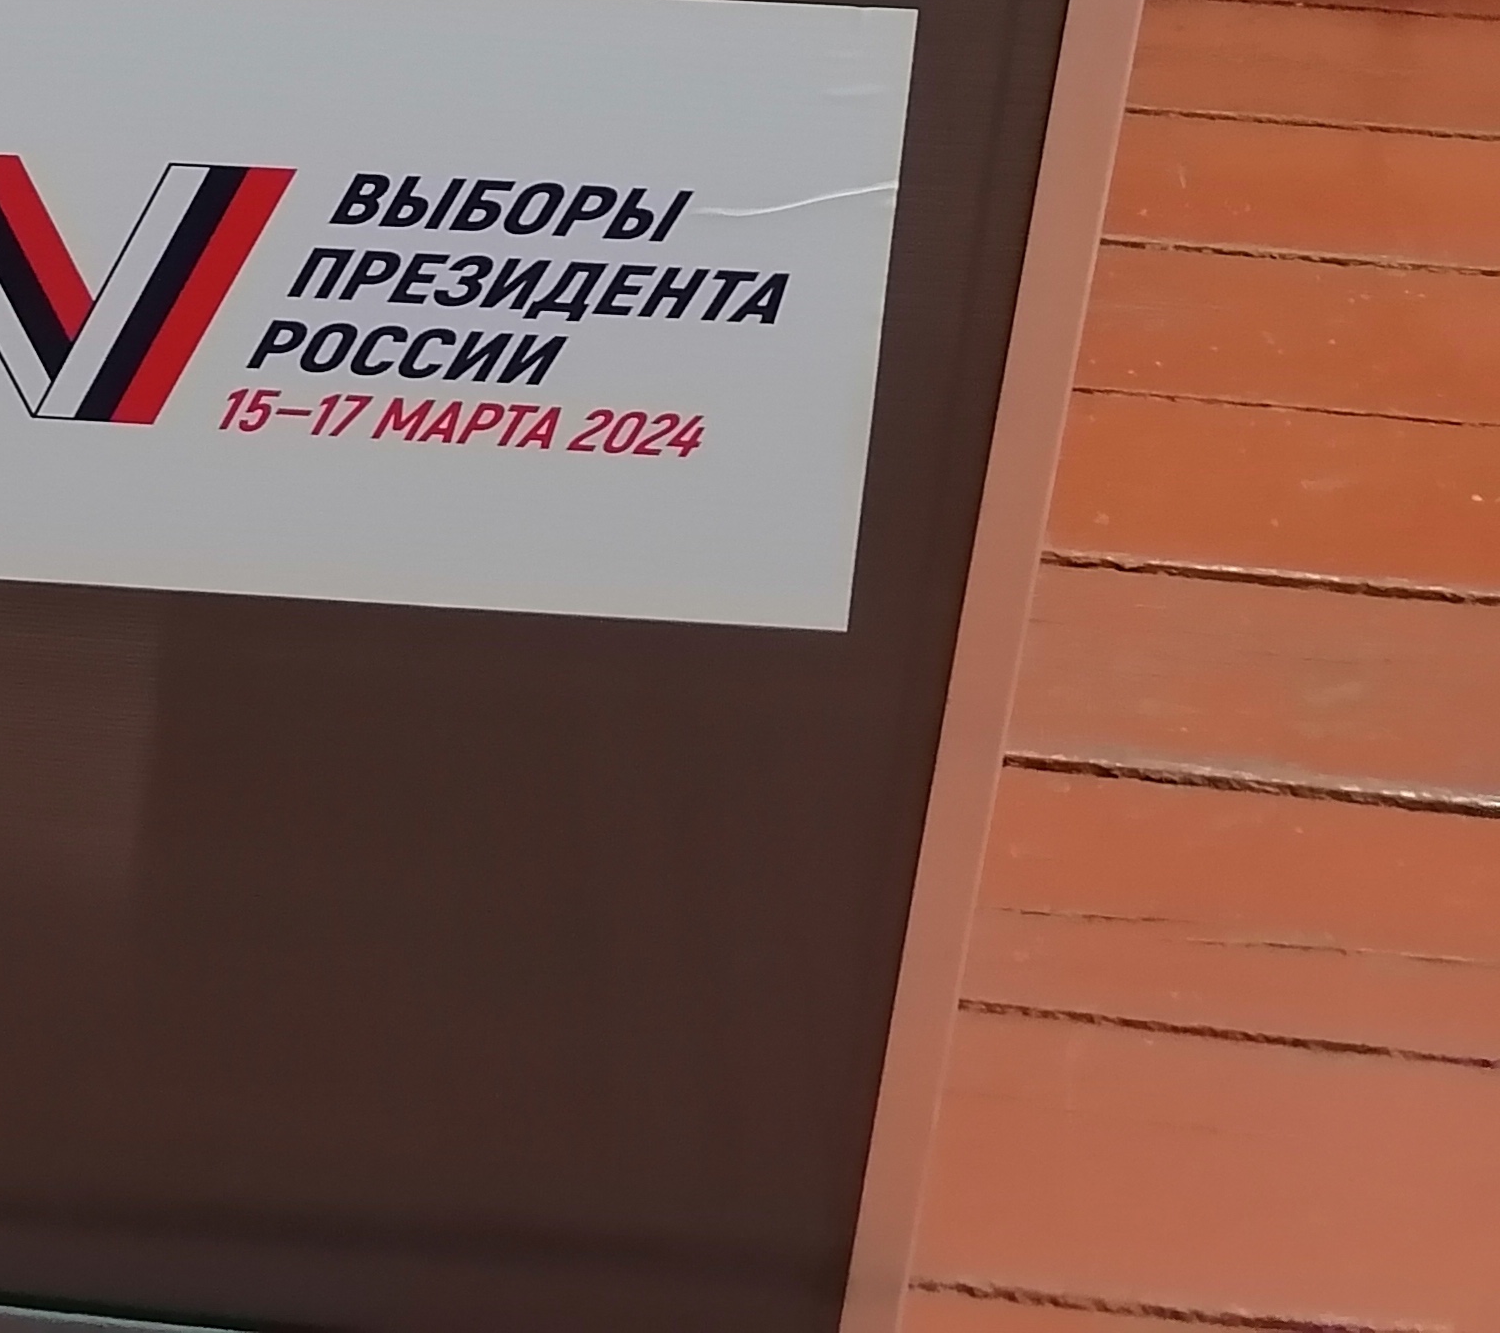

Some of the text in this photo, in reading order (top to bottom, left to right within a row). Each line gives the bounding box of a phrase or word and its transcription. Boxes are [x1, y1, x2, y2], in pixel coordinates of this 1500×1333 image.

[329, 173, 696, 243] ВЫБОРЫ
[286, 247, 791, 326] ПРЕЗИДЕНТА
[245, 318, 569, 386] РОССИИ
[372, 399, 565, 450] МАРТА
[567, 408, 707, 458] 2024
